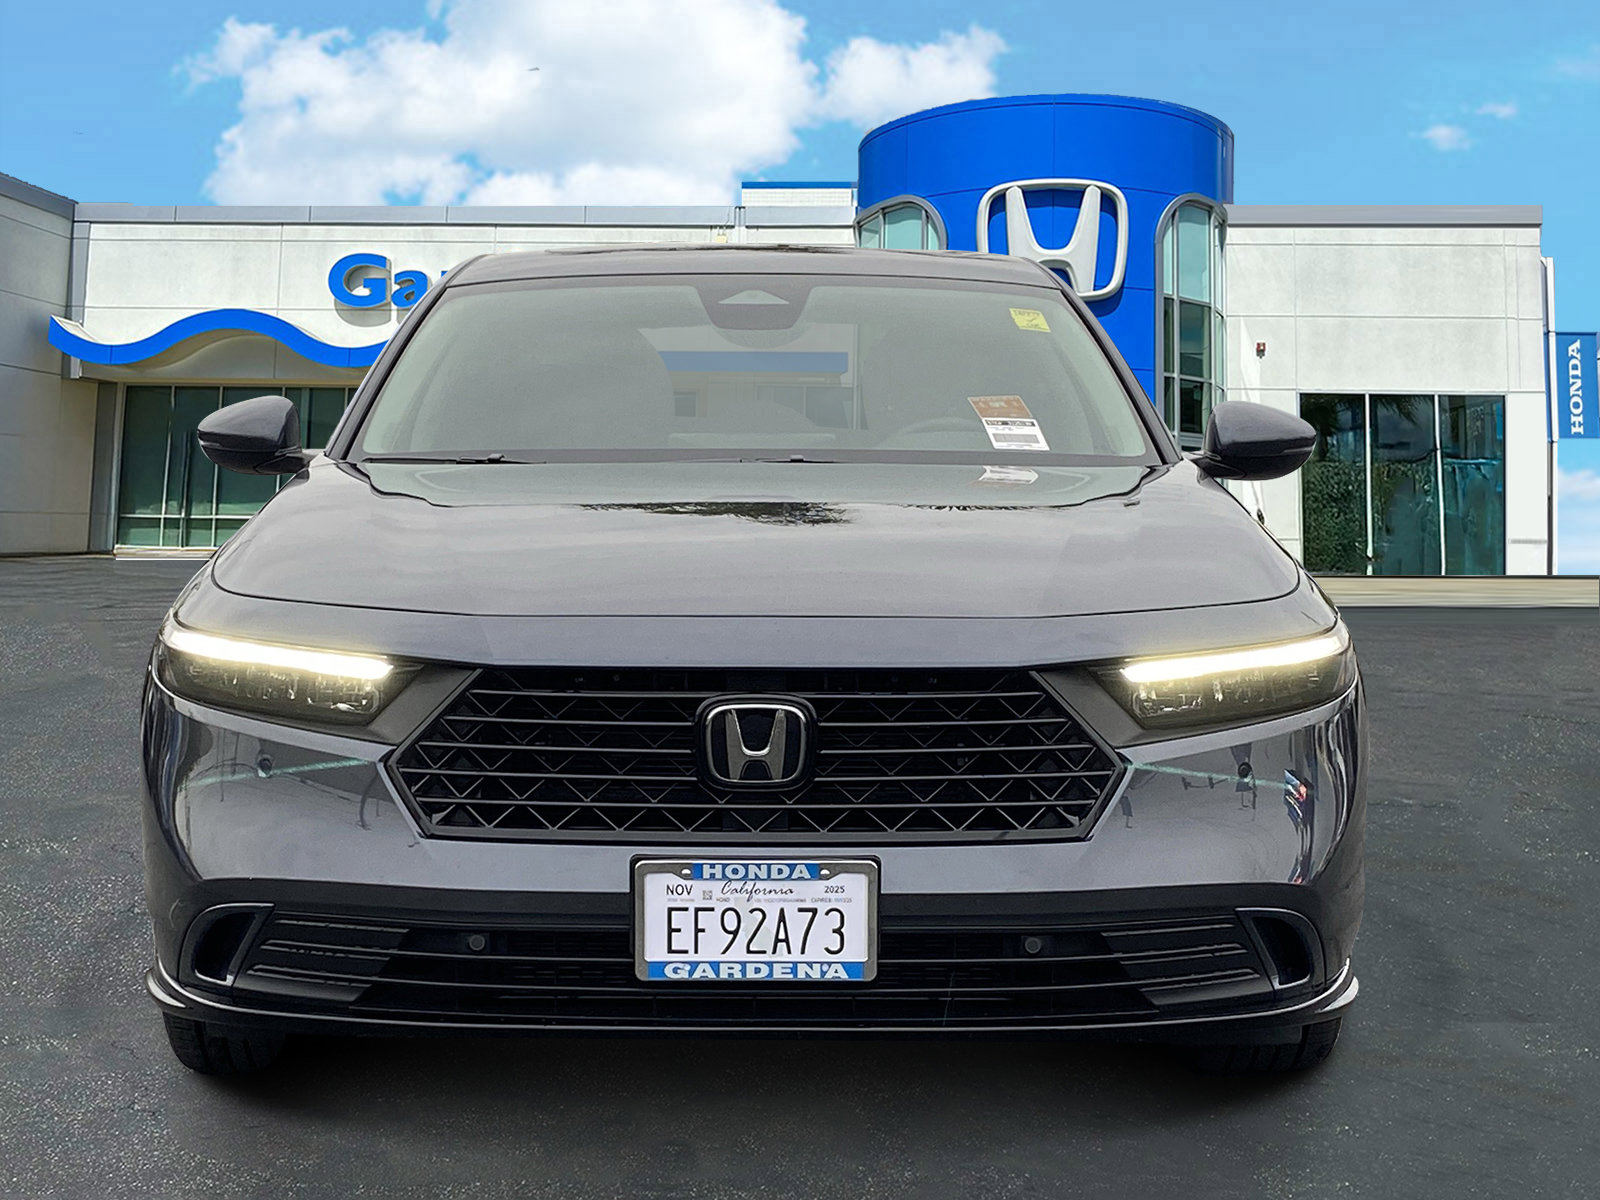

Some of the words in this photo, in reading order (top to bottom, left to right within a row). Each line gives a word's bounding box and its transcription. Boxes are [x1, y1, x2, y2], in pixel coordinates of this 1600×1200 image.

[328, 253, 449, 309] Ga
[1568, 338, 1584, 435] HONDA
[702, 864, 812, 880] HONDA
[666, 884, 693, 896] NOV
[721, 880, 795, 903] California
[824, 885, 846, 894] 2025
[667, 907, 845, 955] EF92A73
[663, 962, 849, 979] GARDENA
